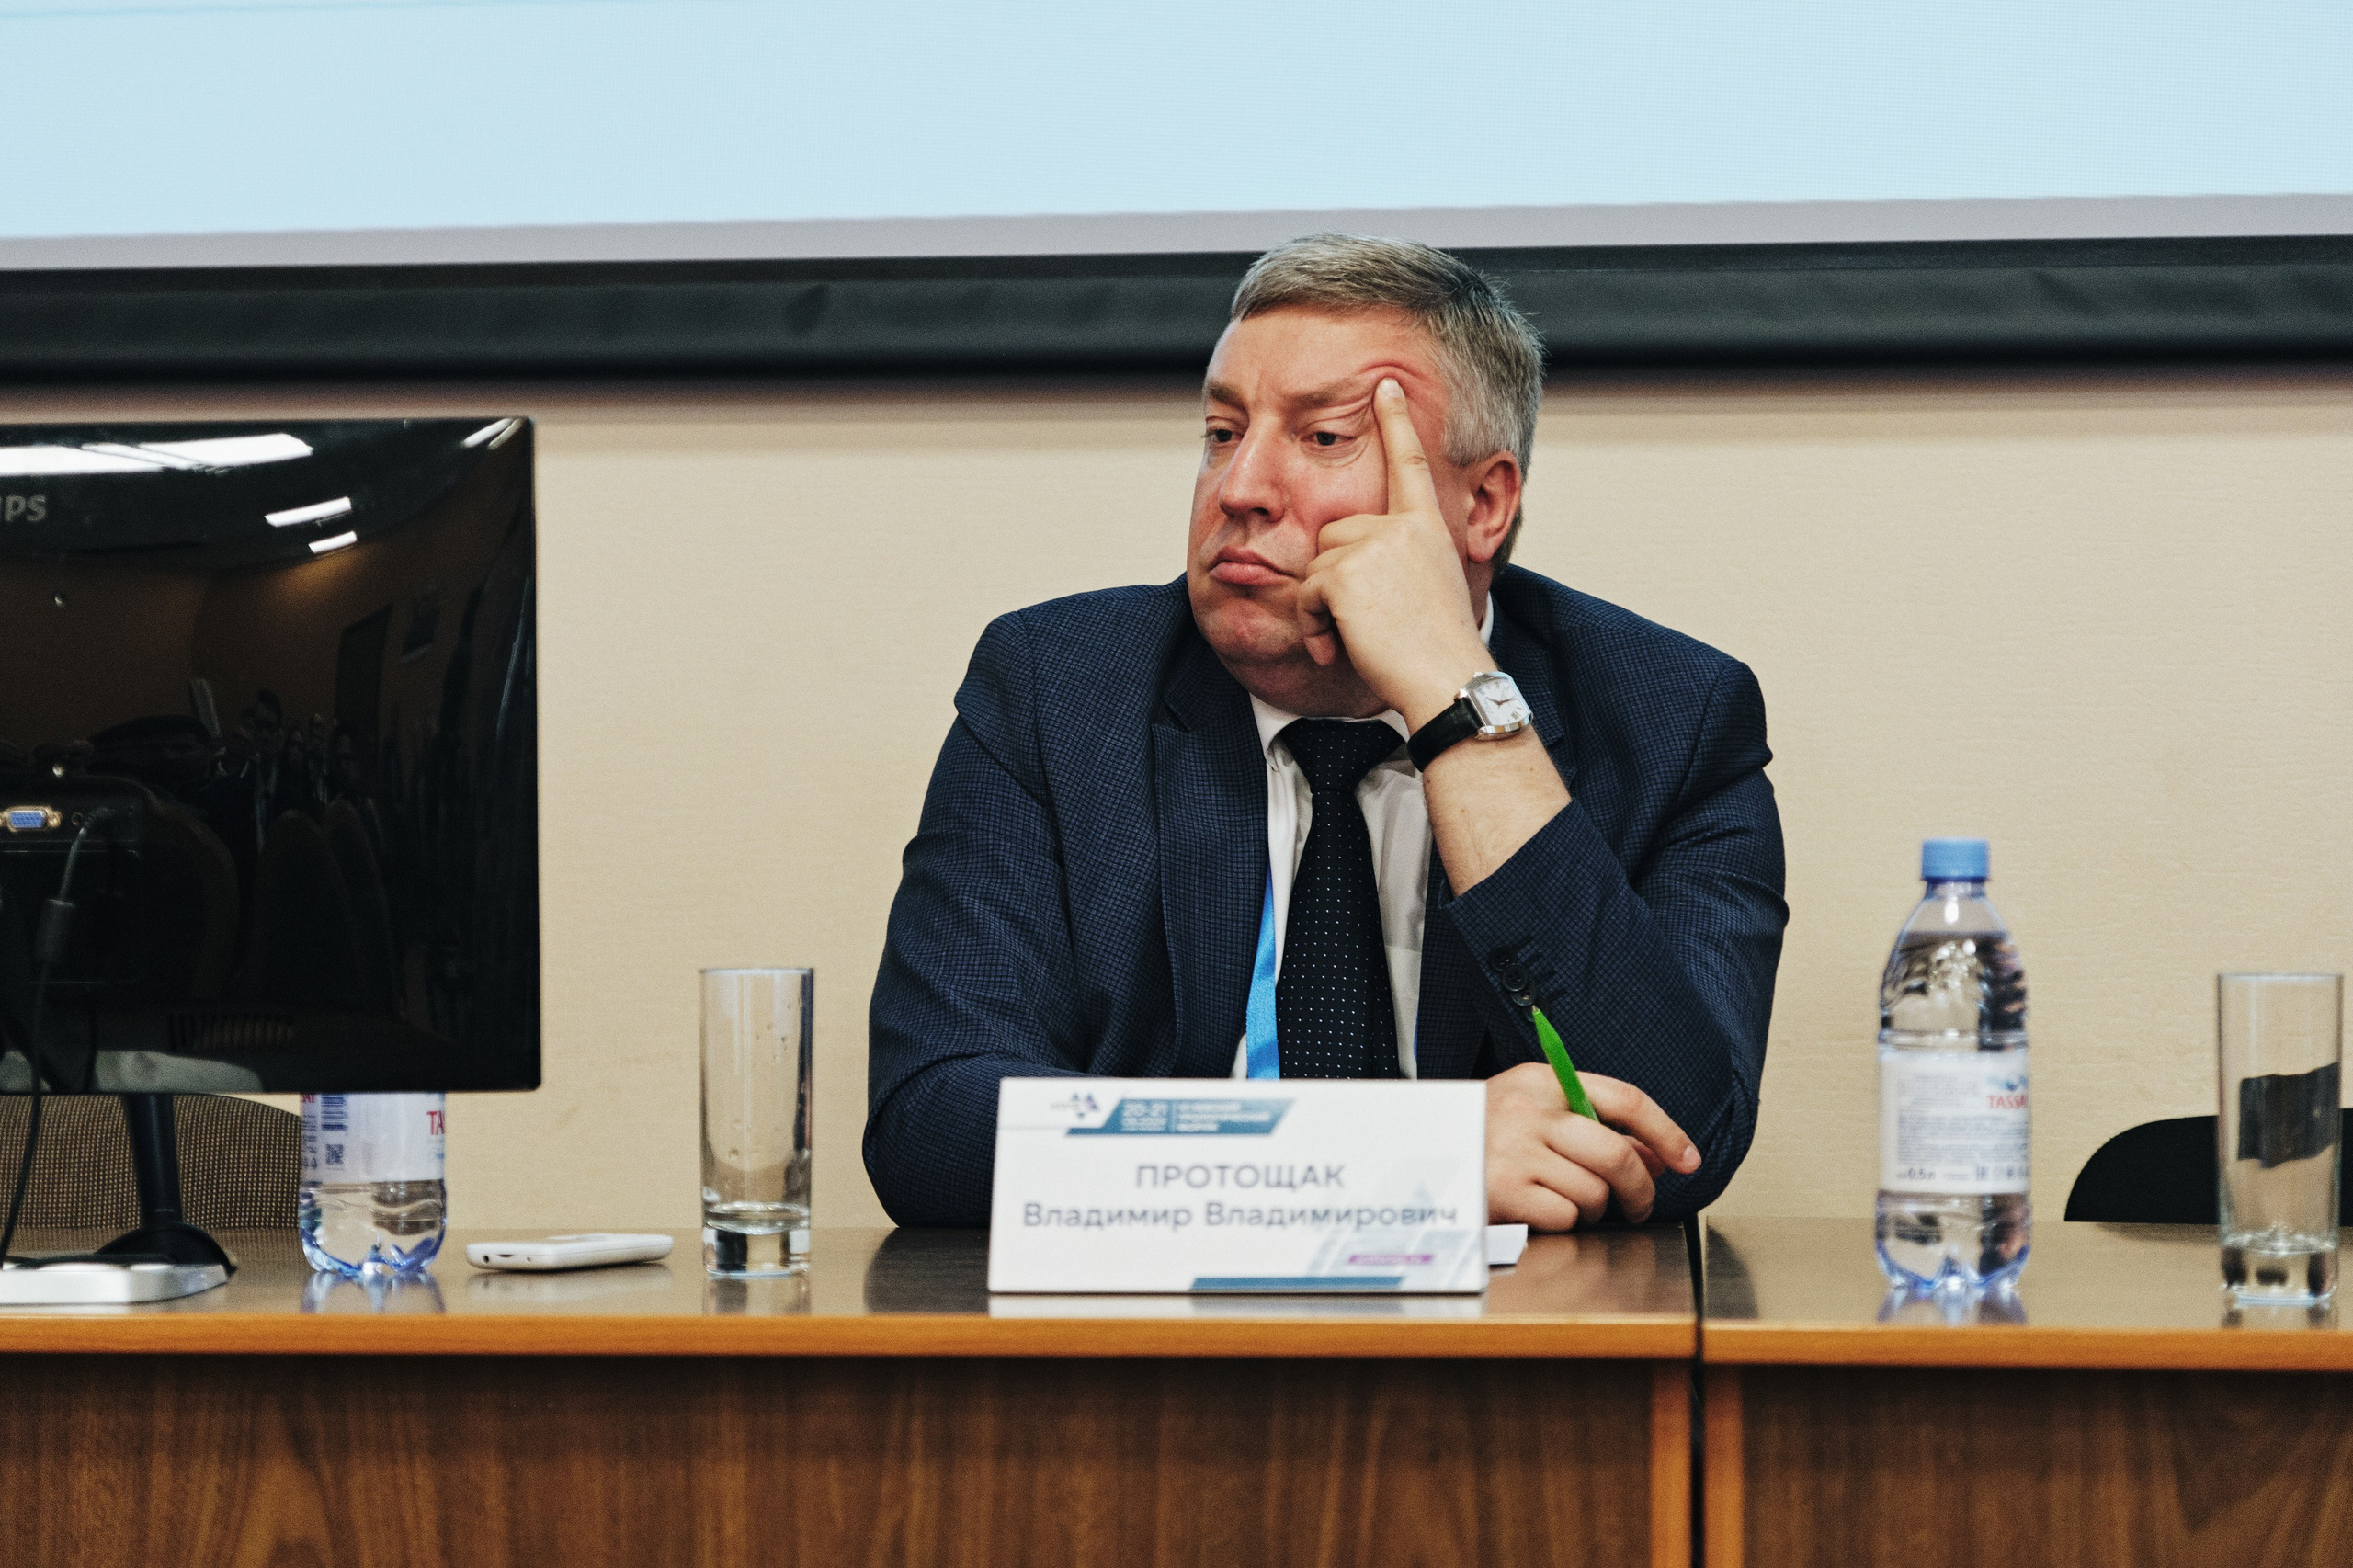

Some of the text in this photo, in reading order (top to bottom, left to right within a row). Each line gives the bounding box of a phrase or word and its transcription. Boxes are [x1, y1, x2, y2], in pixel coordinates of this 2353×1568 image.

[1136, 1164, 1346, 1191] ПРОТОЩАК
[1024, 1201, 1458, 1232] Владимир Владимирович
